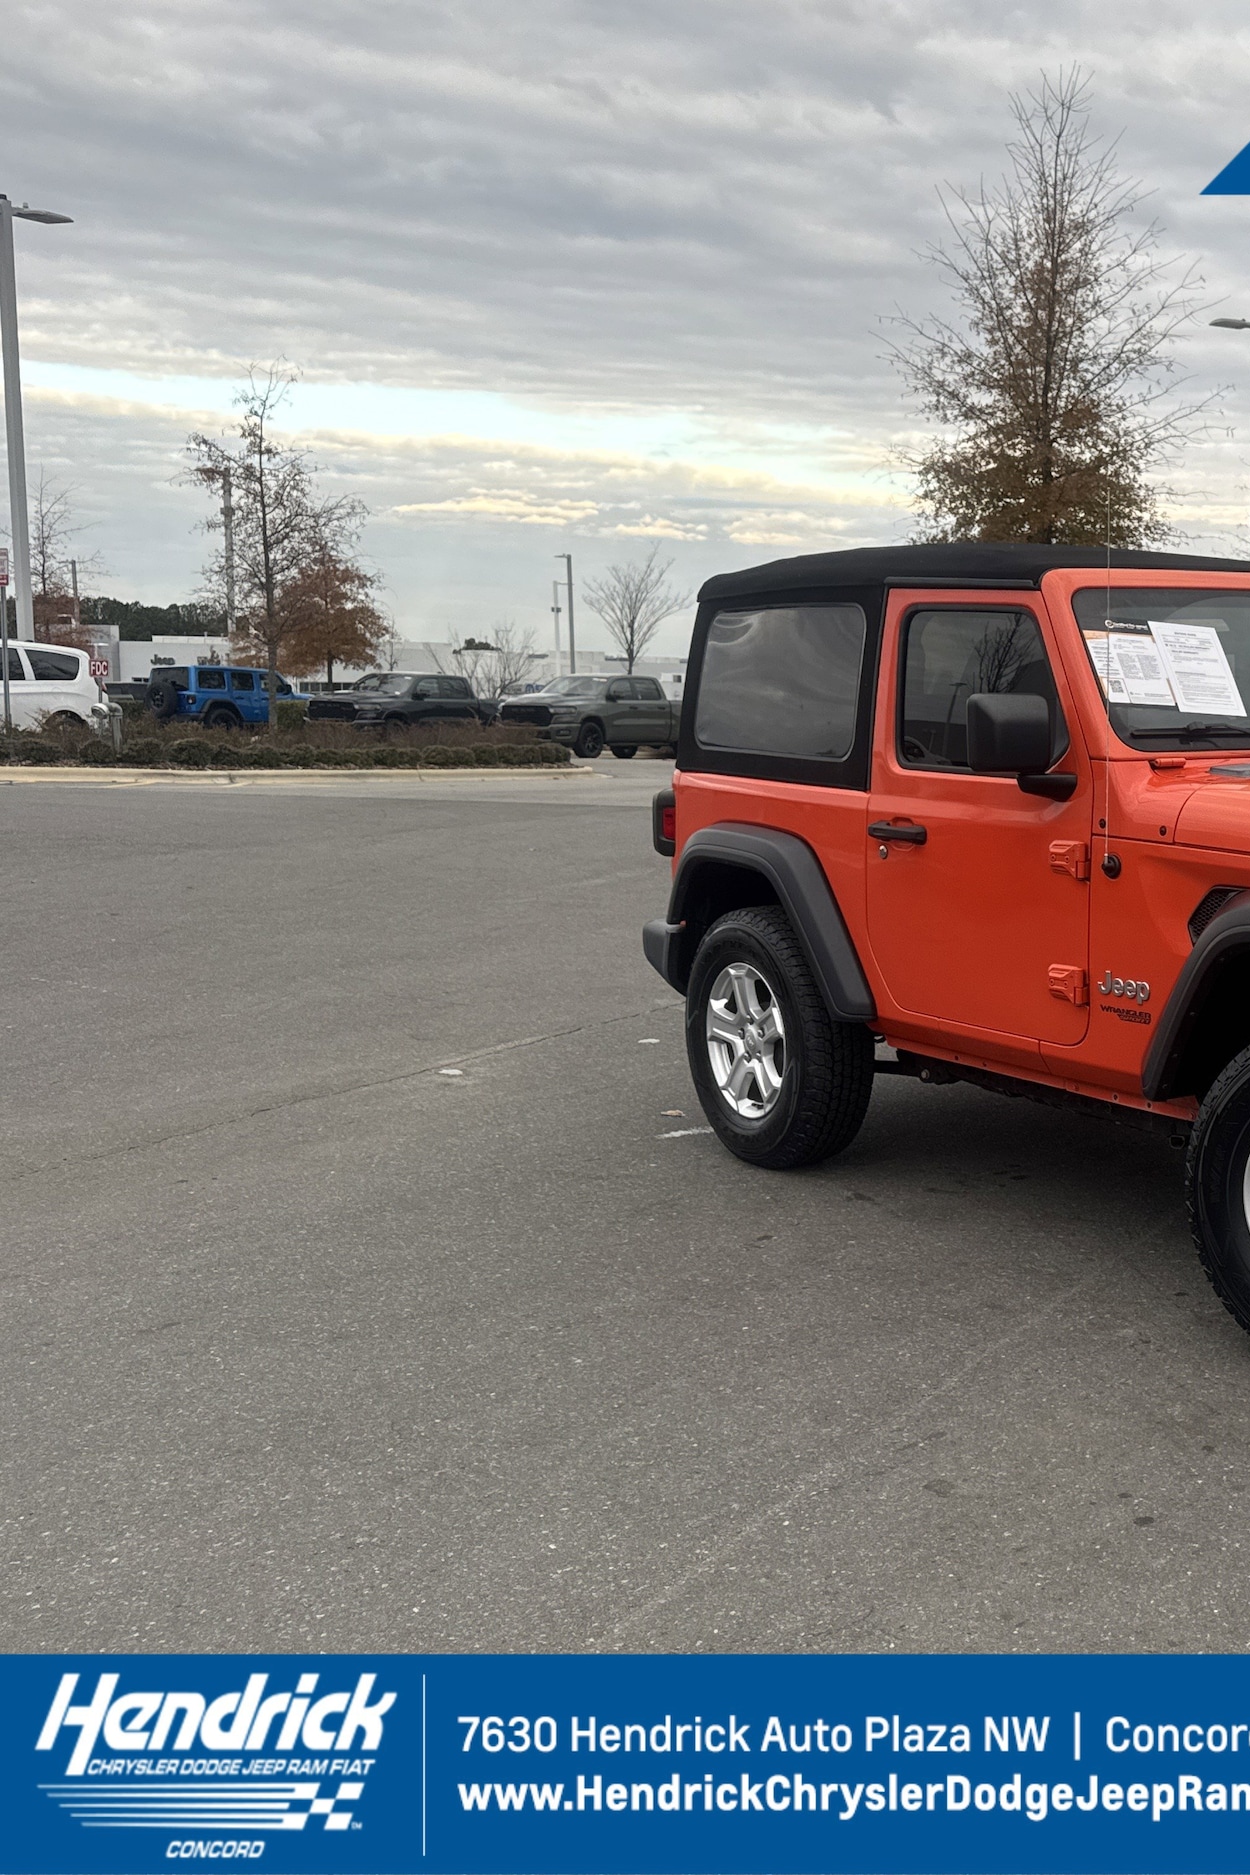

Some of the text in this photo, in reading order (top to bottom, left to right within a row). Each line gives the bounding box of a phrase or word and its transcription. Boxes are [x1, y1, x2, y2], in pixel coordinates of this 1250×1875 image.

[90, 661, 108, 675] FDC
[1097, 970, 1150, 1004] Jeep
[1100, 1004, 1151, 1019] WRANGLER
